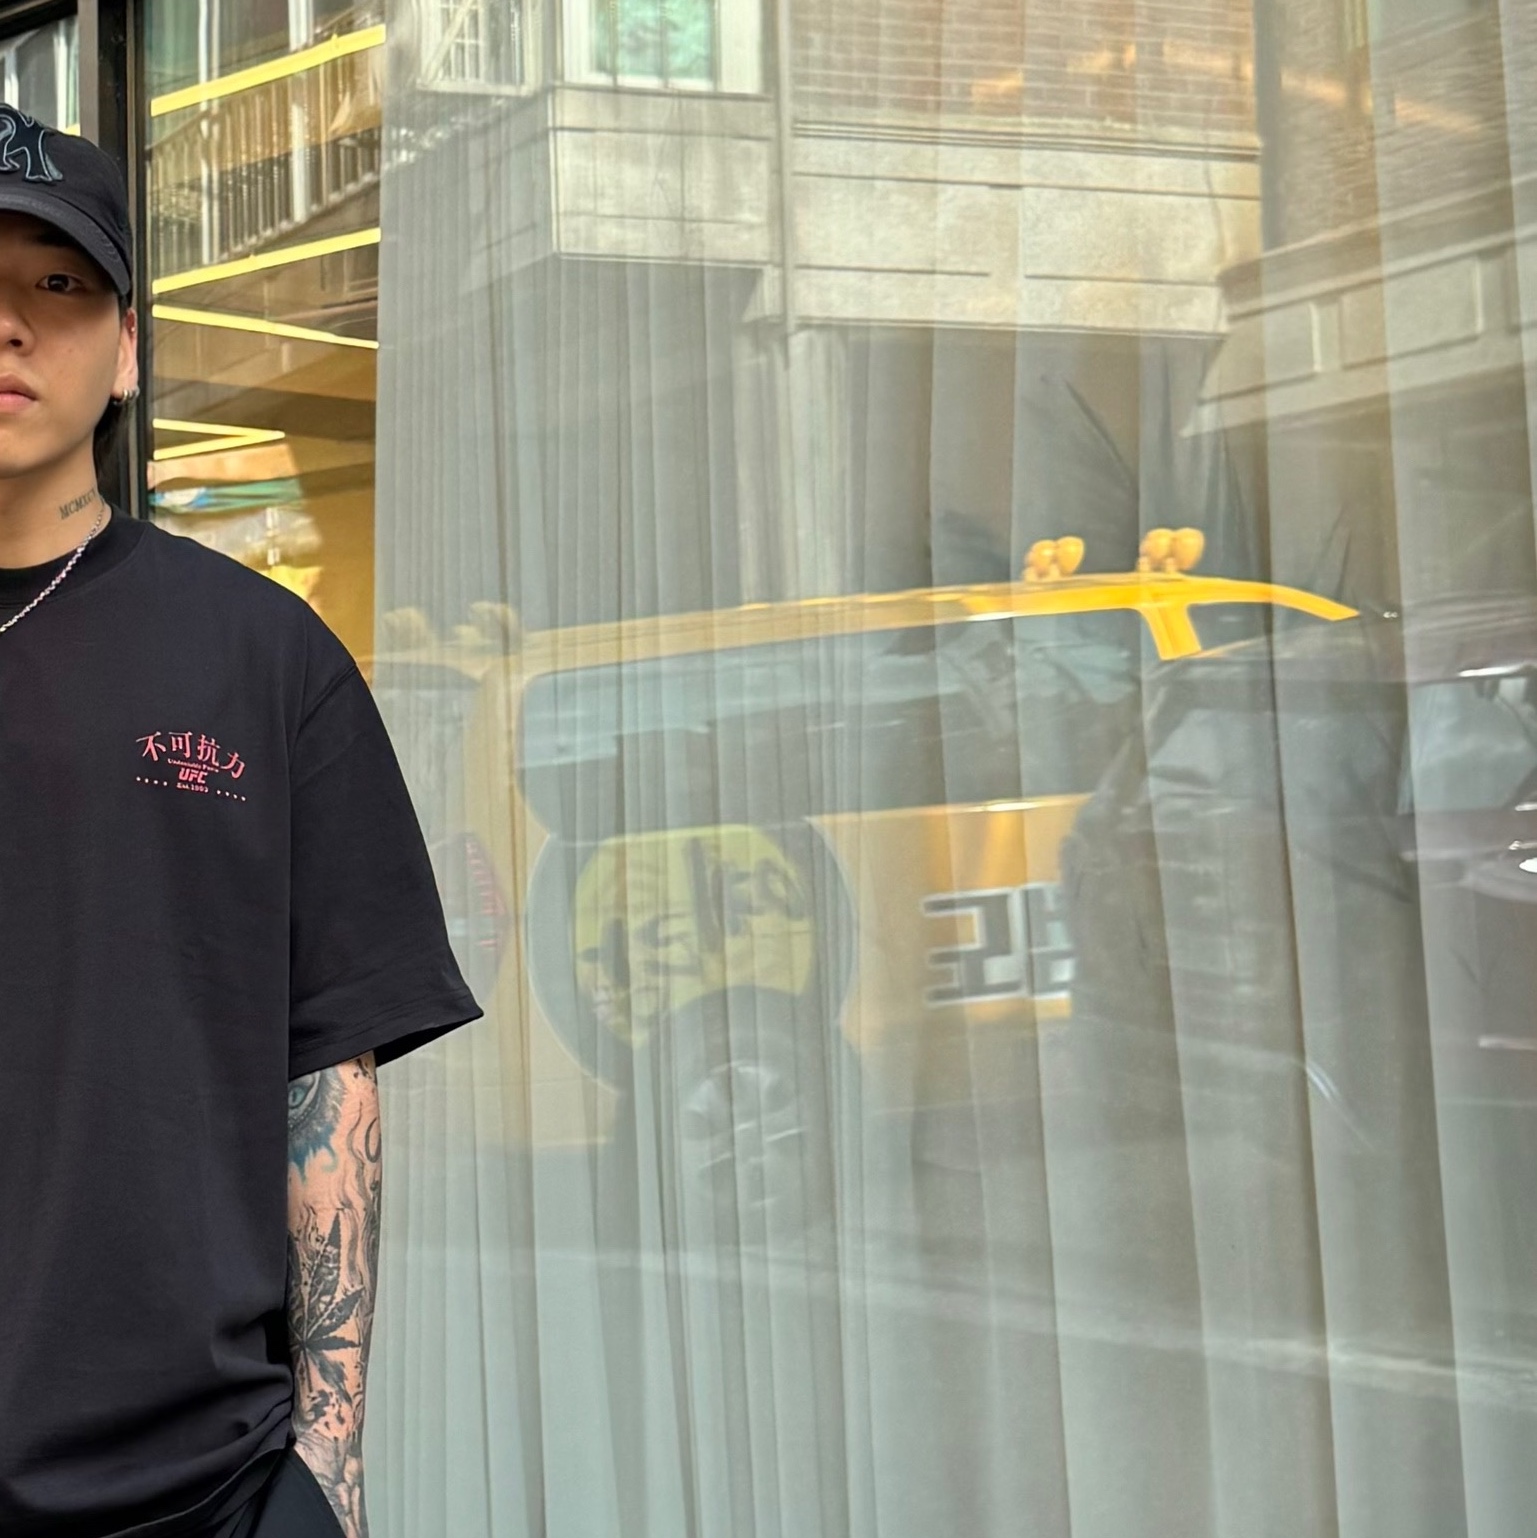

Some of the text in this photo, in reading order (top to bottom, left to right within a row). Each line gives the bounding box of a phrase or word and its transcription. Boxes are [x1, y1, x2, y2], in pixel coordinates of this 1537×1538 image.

[135, 731, 245, 779] 不可抗力
[179, 767, 208, 783] UFC
